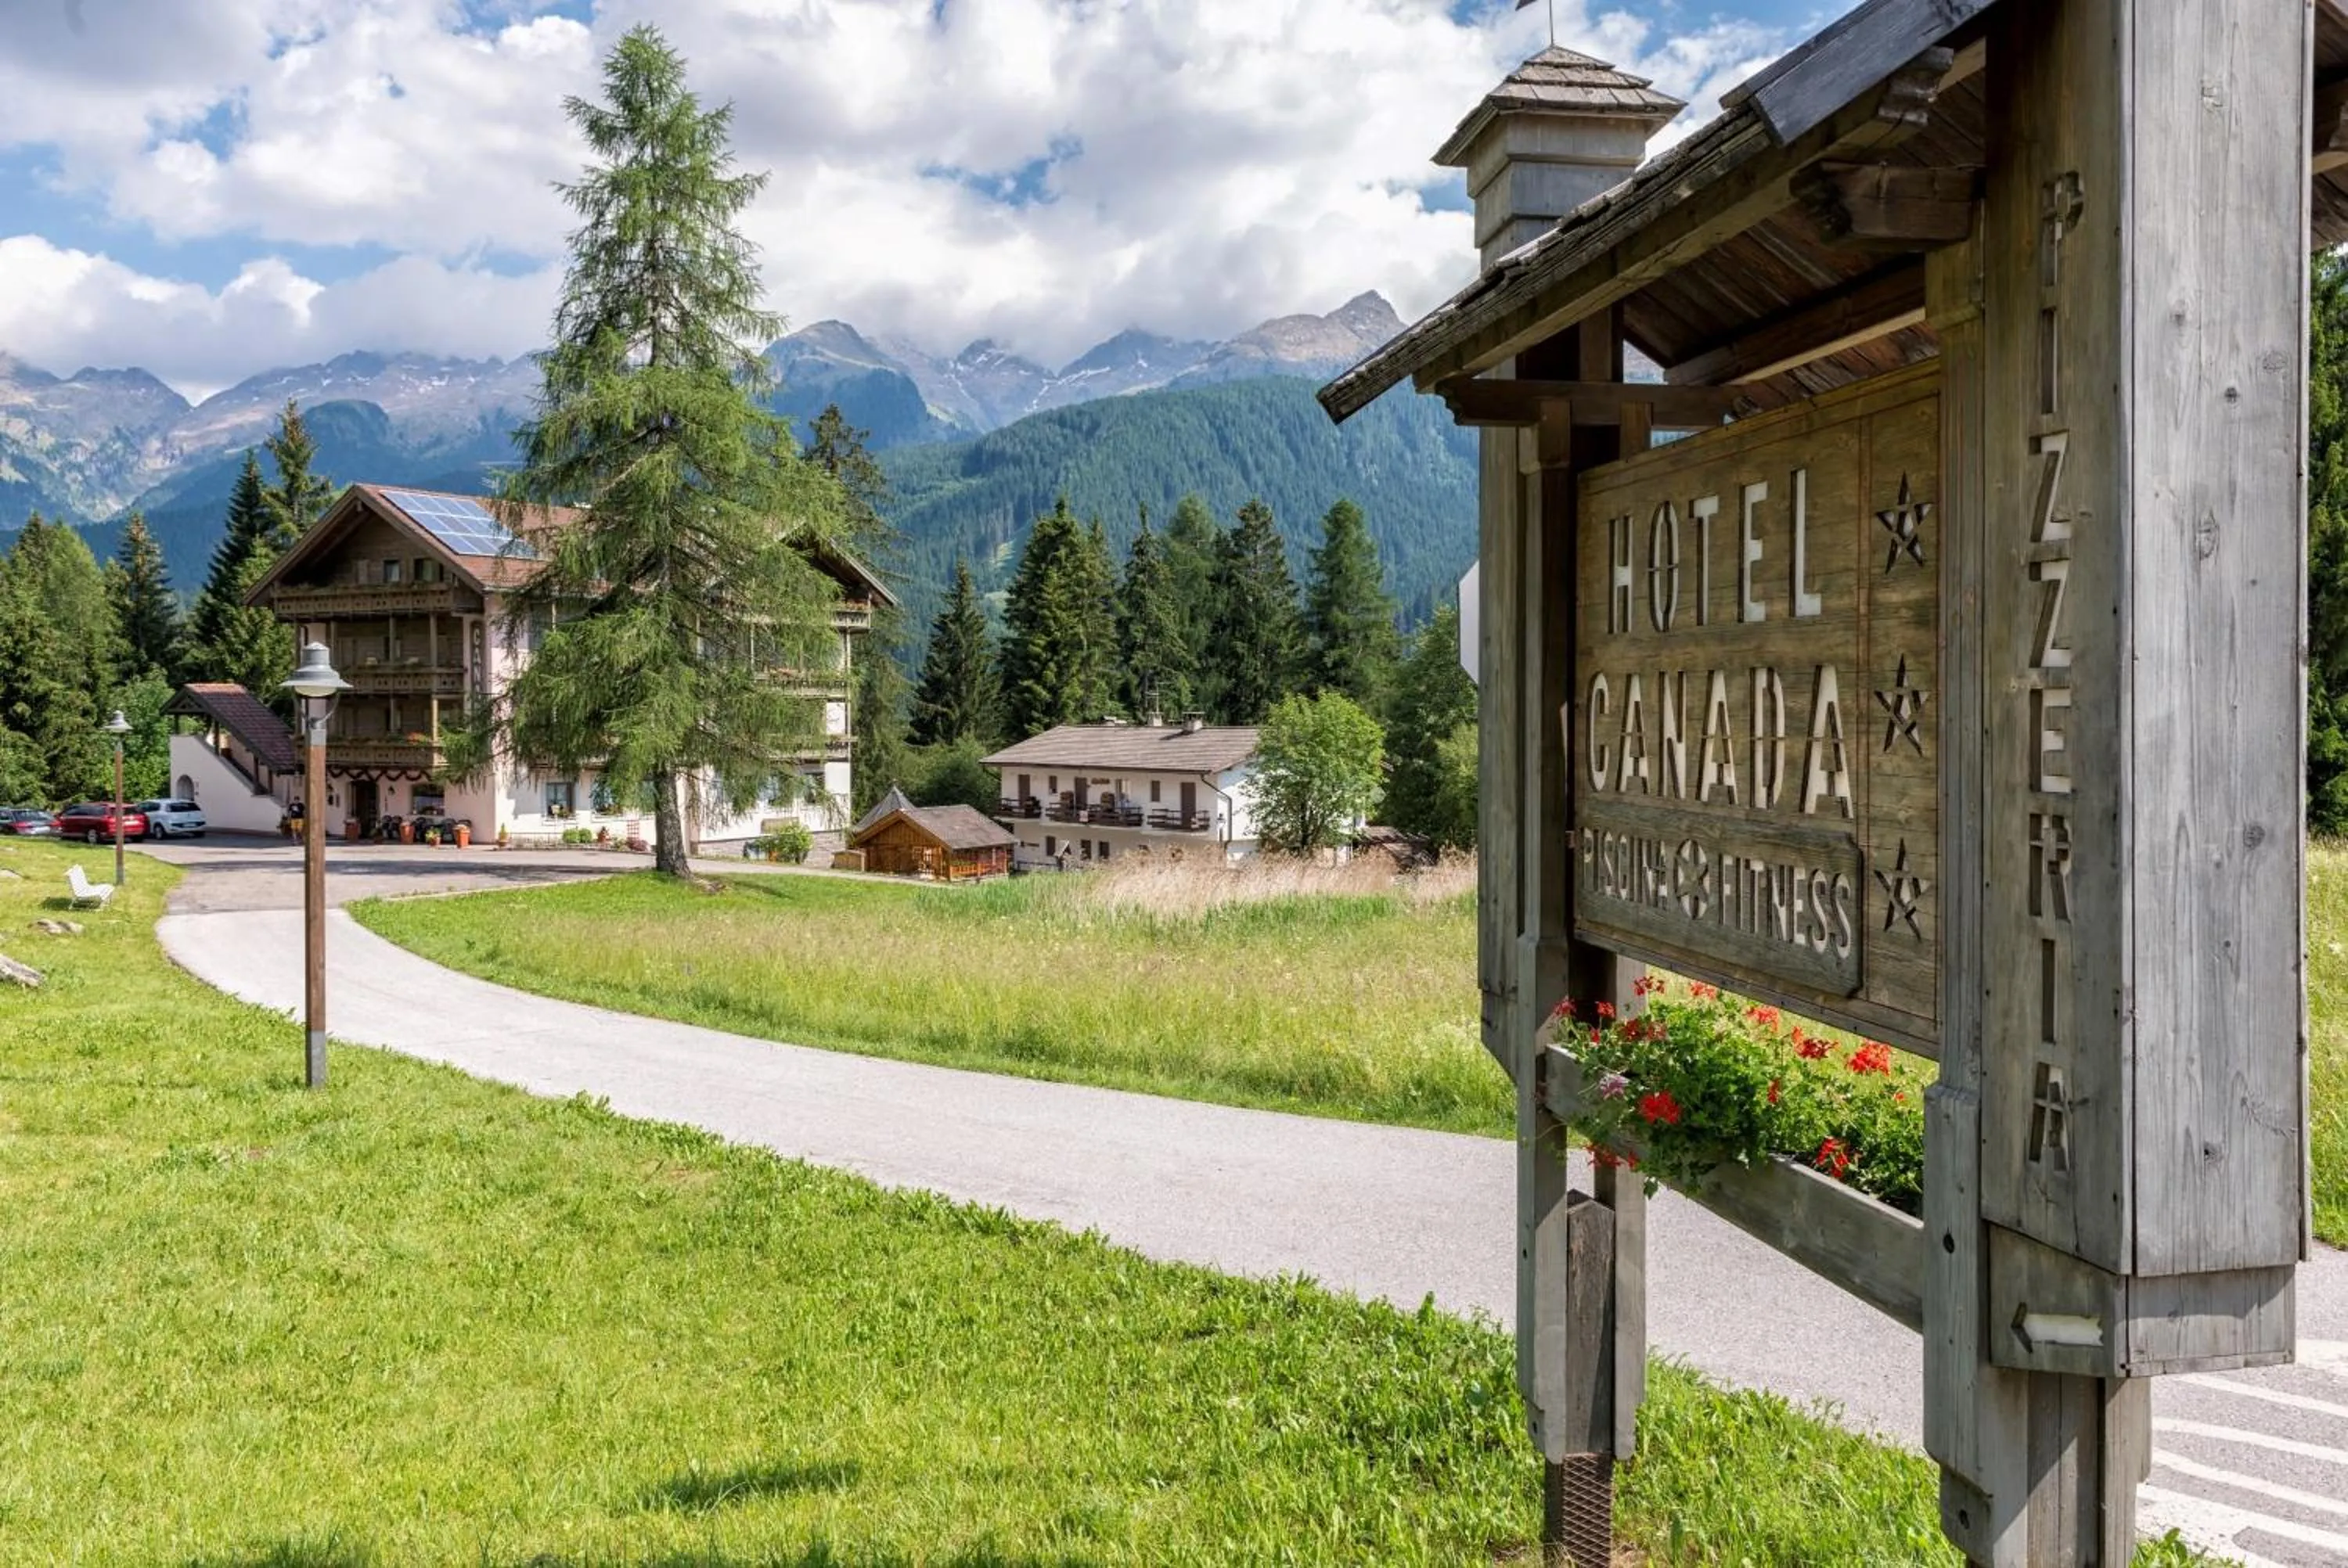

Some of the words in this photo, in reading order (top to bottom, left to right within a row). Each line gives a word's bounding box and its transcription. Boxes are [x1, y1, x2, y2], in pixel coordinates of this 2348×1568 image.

[1608, 469, 1822, 635] HOTEL
[1586, 664, 1854, 820] CANADA
[2029, 170, 2084, 1173] PIZZERIA
[1579, 826, 1669, 912] PISCINA
[1718, 854, 1852, 959] FITNESS
